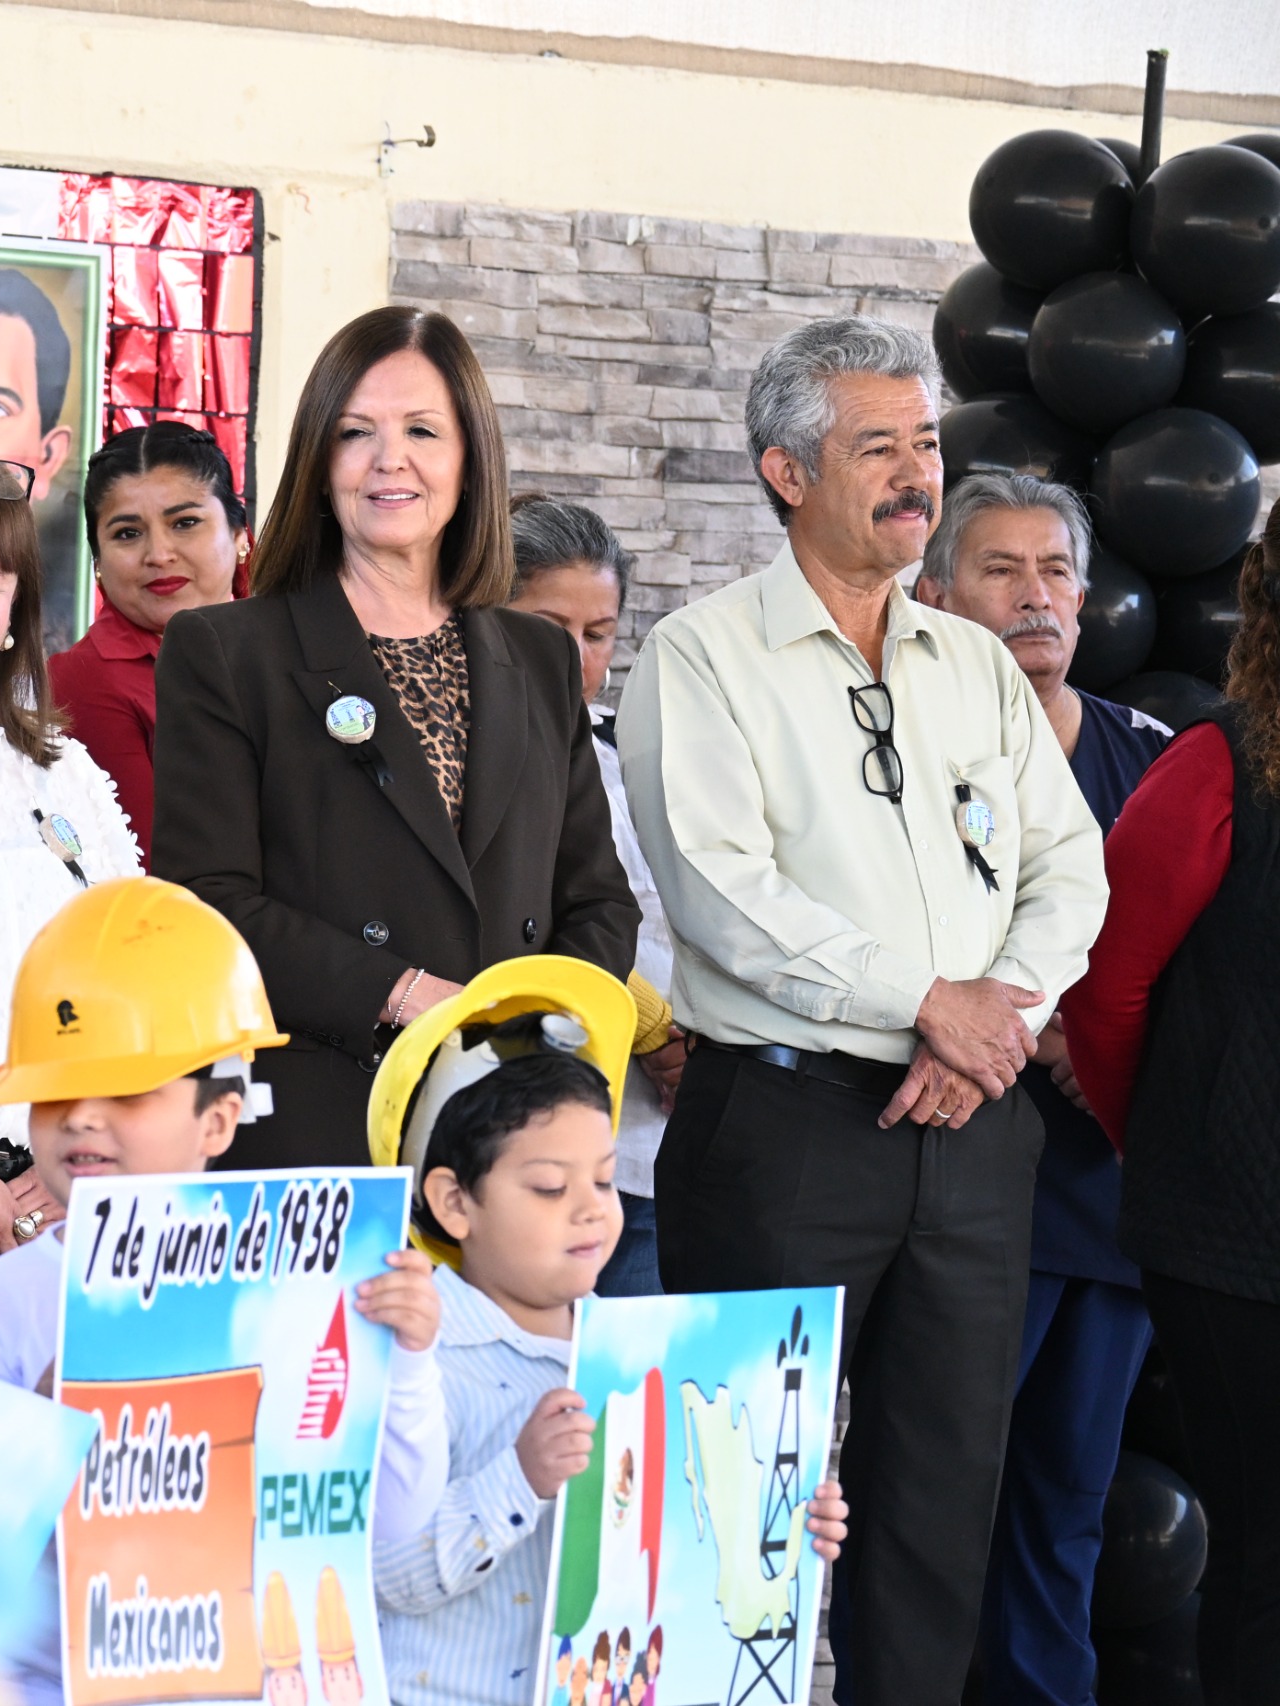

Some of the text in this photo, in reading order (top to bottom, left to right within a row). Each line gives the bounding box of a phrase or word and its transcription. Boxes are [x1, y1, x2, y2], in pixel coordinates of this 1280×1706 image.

[112, 1196, 144, 1279] de
[143, 1200, 231, 1300] junio
[234, 1190, 267, 1274] de
[274, 1186, 349, 1277] 1938
[83, 1414, 206, 1511] Petróleos
[261, 1470, 370, 1540] PEMEX
[89, 1582, 221, 1670] Mexicanos
